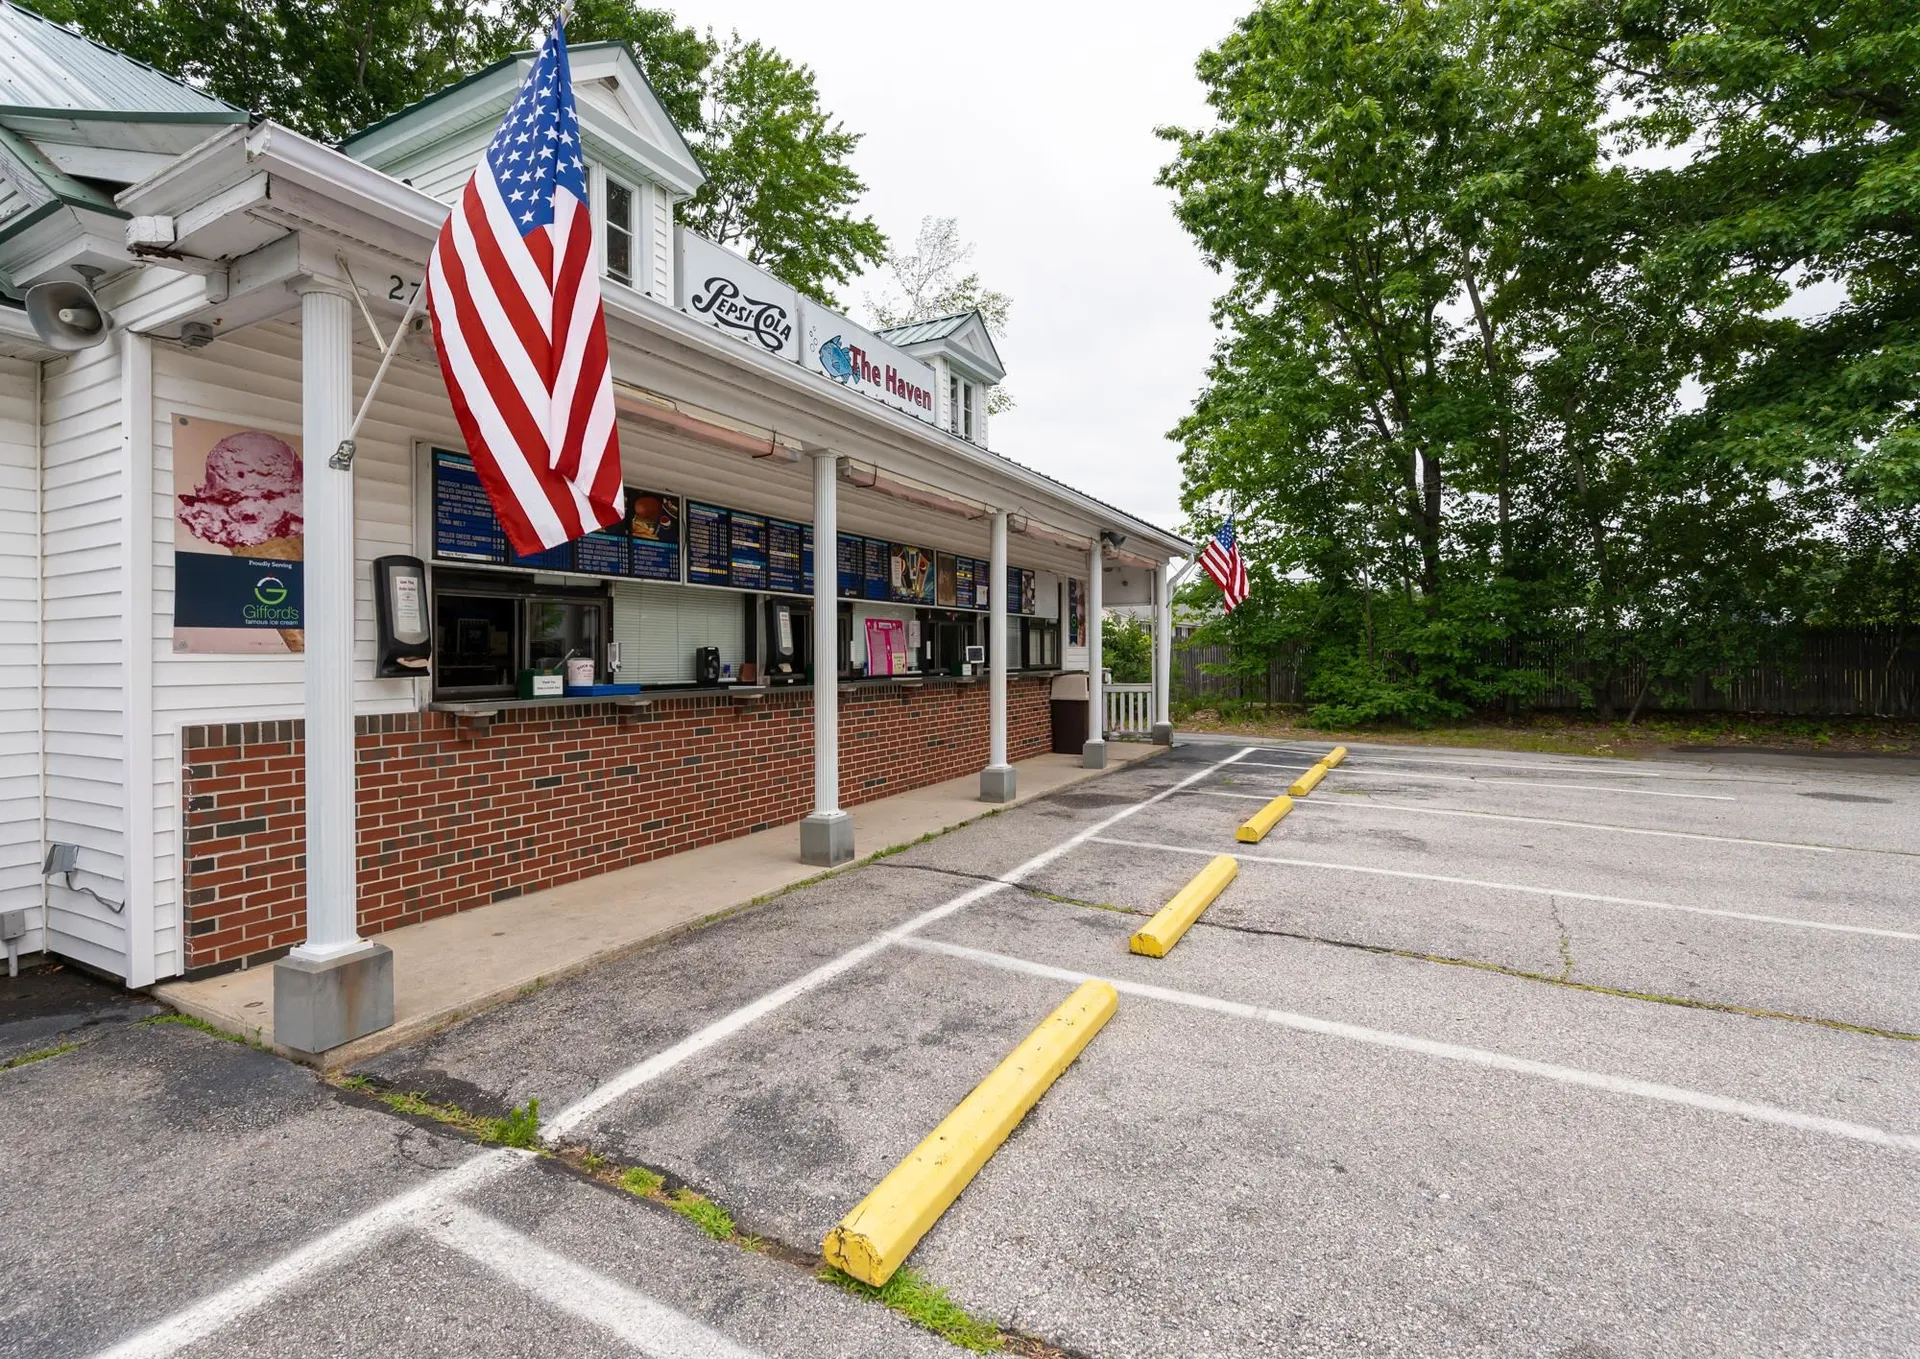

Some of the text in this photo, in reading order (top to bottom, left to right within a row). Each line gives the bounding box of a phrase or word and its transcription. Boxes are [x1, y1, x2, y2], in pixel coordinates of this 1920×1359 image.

[849, 344, 932, 411] The Haven
[249, 560, 271, 568] Proudly
[243, 604, 299, 619] Gifford's
